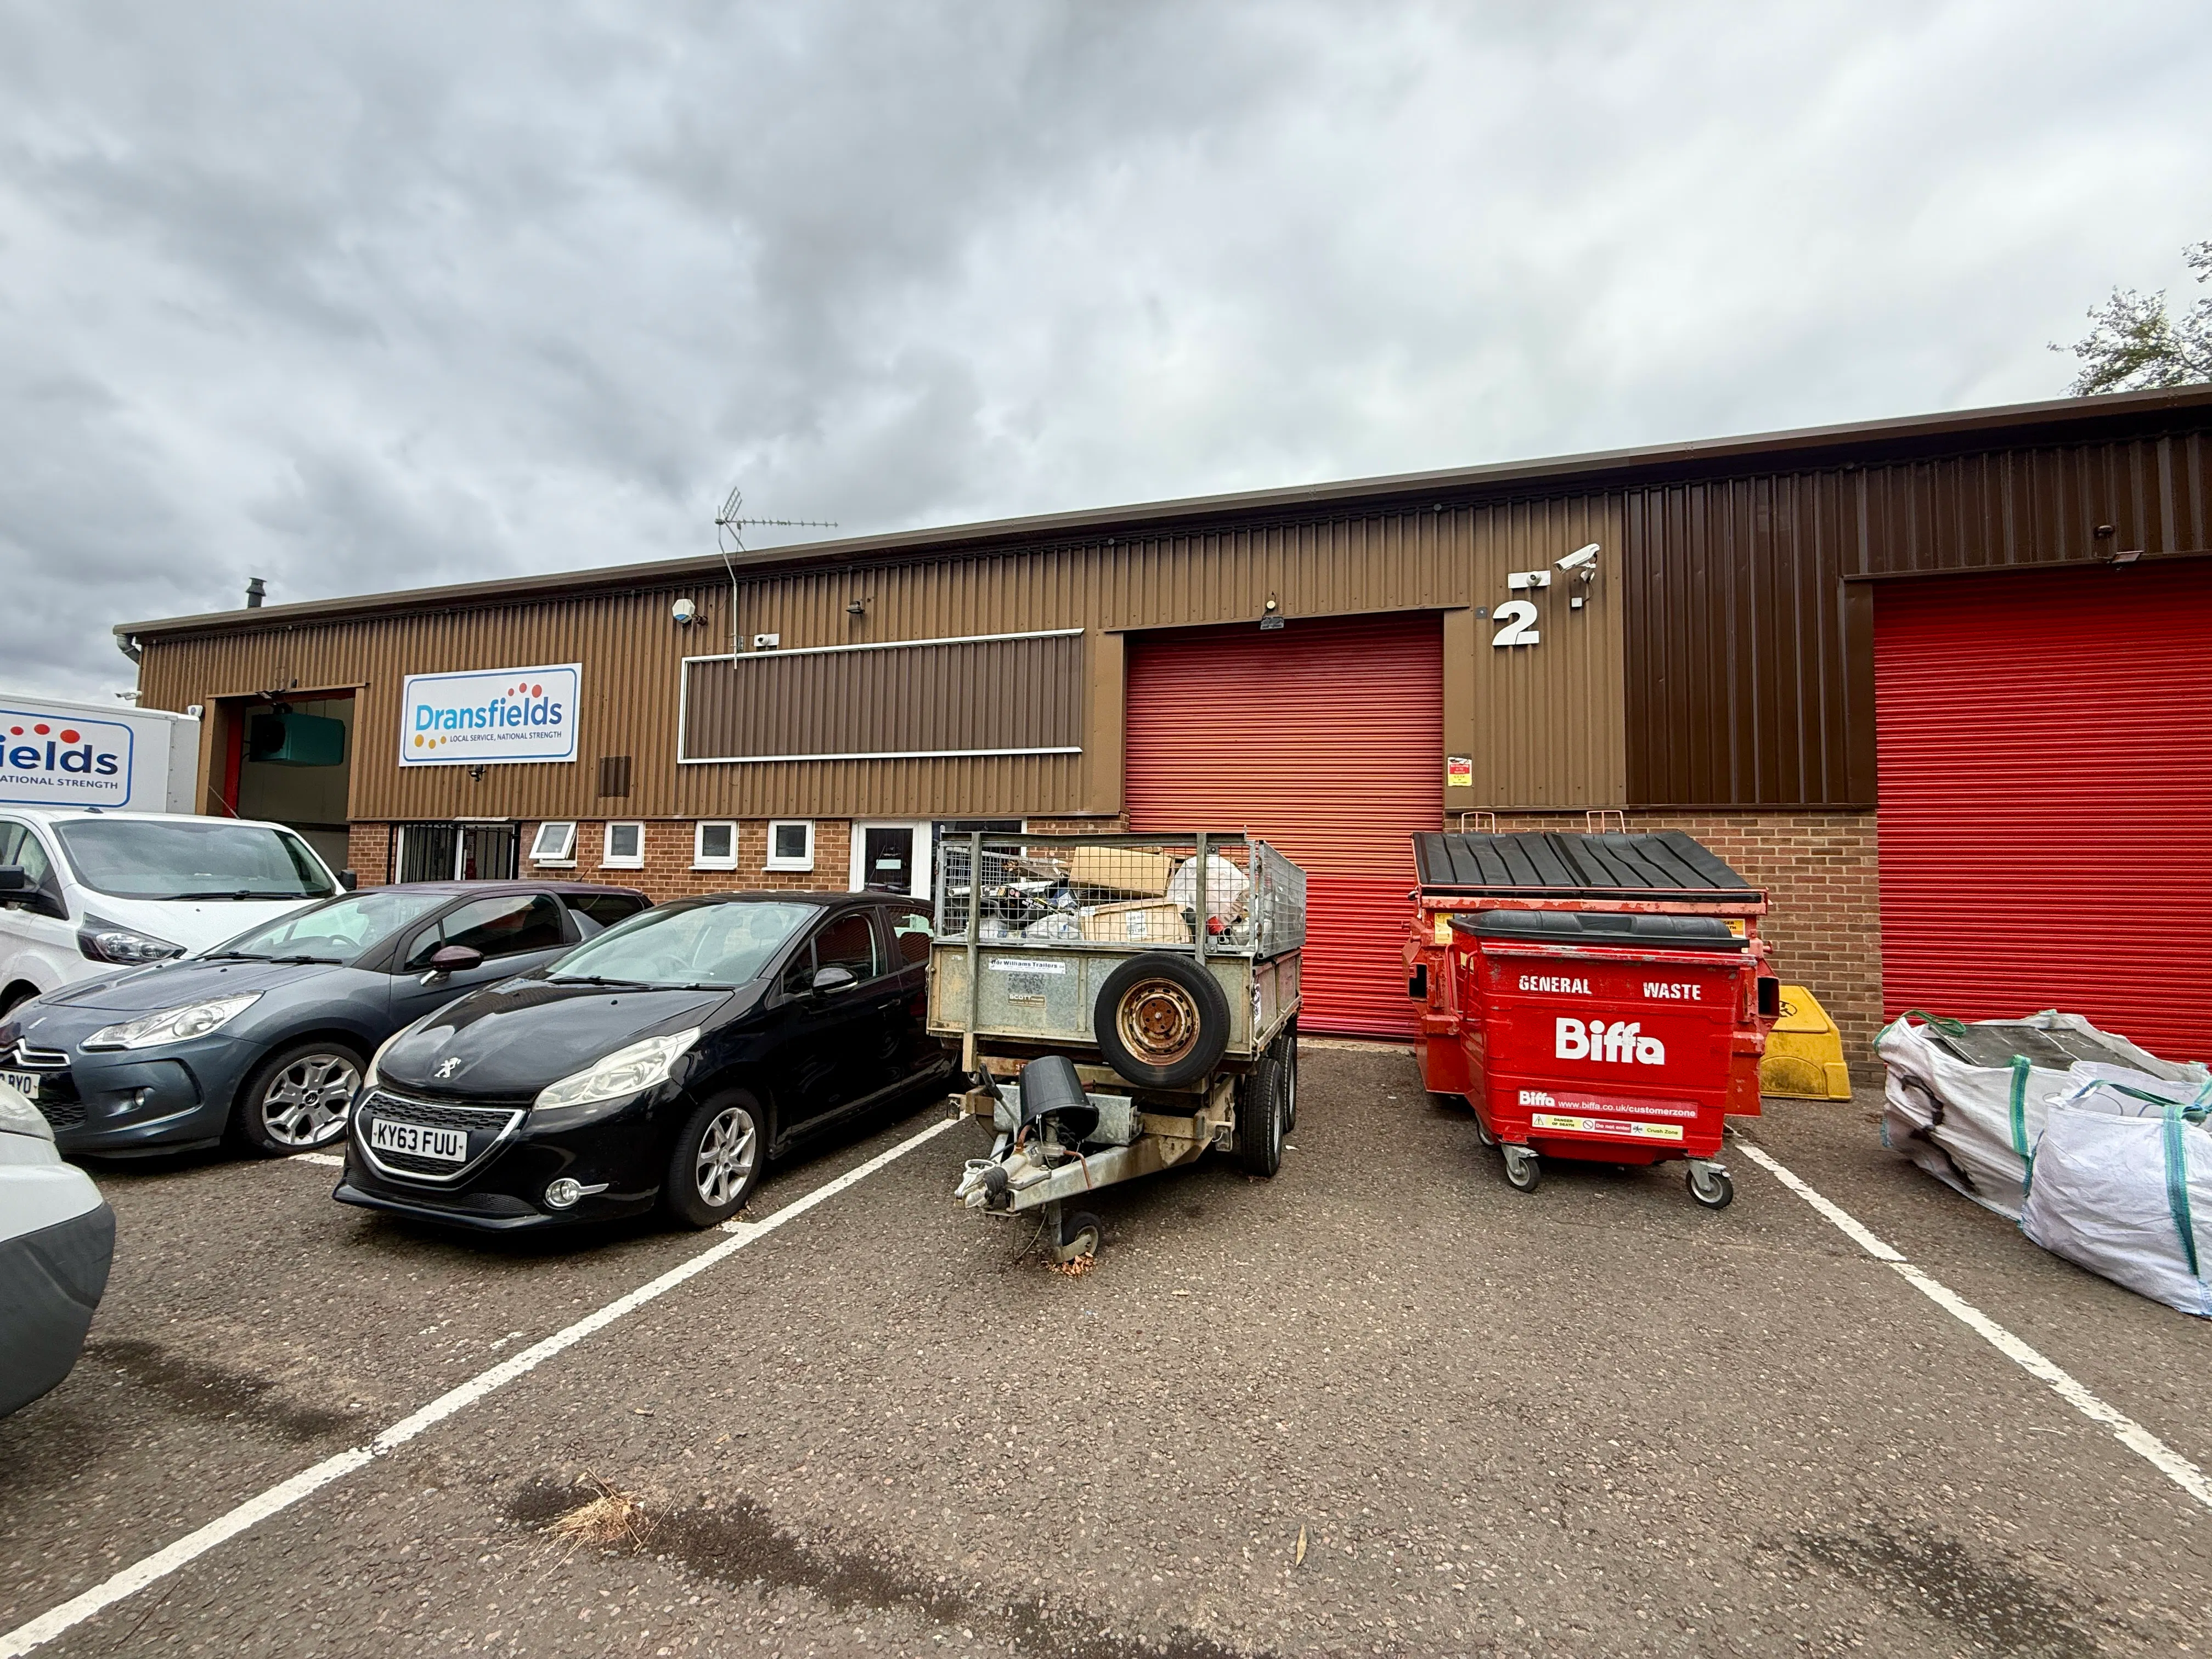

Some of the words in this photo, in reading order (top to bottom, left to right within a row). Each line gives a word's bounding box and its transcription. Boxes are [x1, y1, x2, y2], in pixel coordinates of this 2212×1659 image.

[1492, 600, 1539, 645] 2
[415, 697, 562, 731] Dransfields
[470, 733, 496, 742] SERVICE,
[497, 732, 528, 741] NATIONAL
[57, 778, 118, 789] STRENGTH
[1519, 975, 1593, 994] GENERAL
[1643, 982, 1701, 1000] WASTE
[1556, 1017, 1665, 1065] Biffa
[1519, 1091, 1555, 1106] Biffa
[1558, 1101, 1696, 1117] www.biffa.co.uk/customerzone
[377, 1123, 417, 1150] KY63
[422, 1131, 458, 1156] FUU
